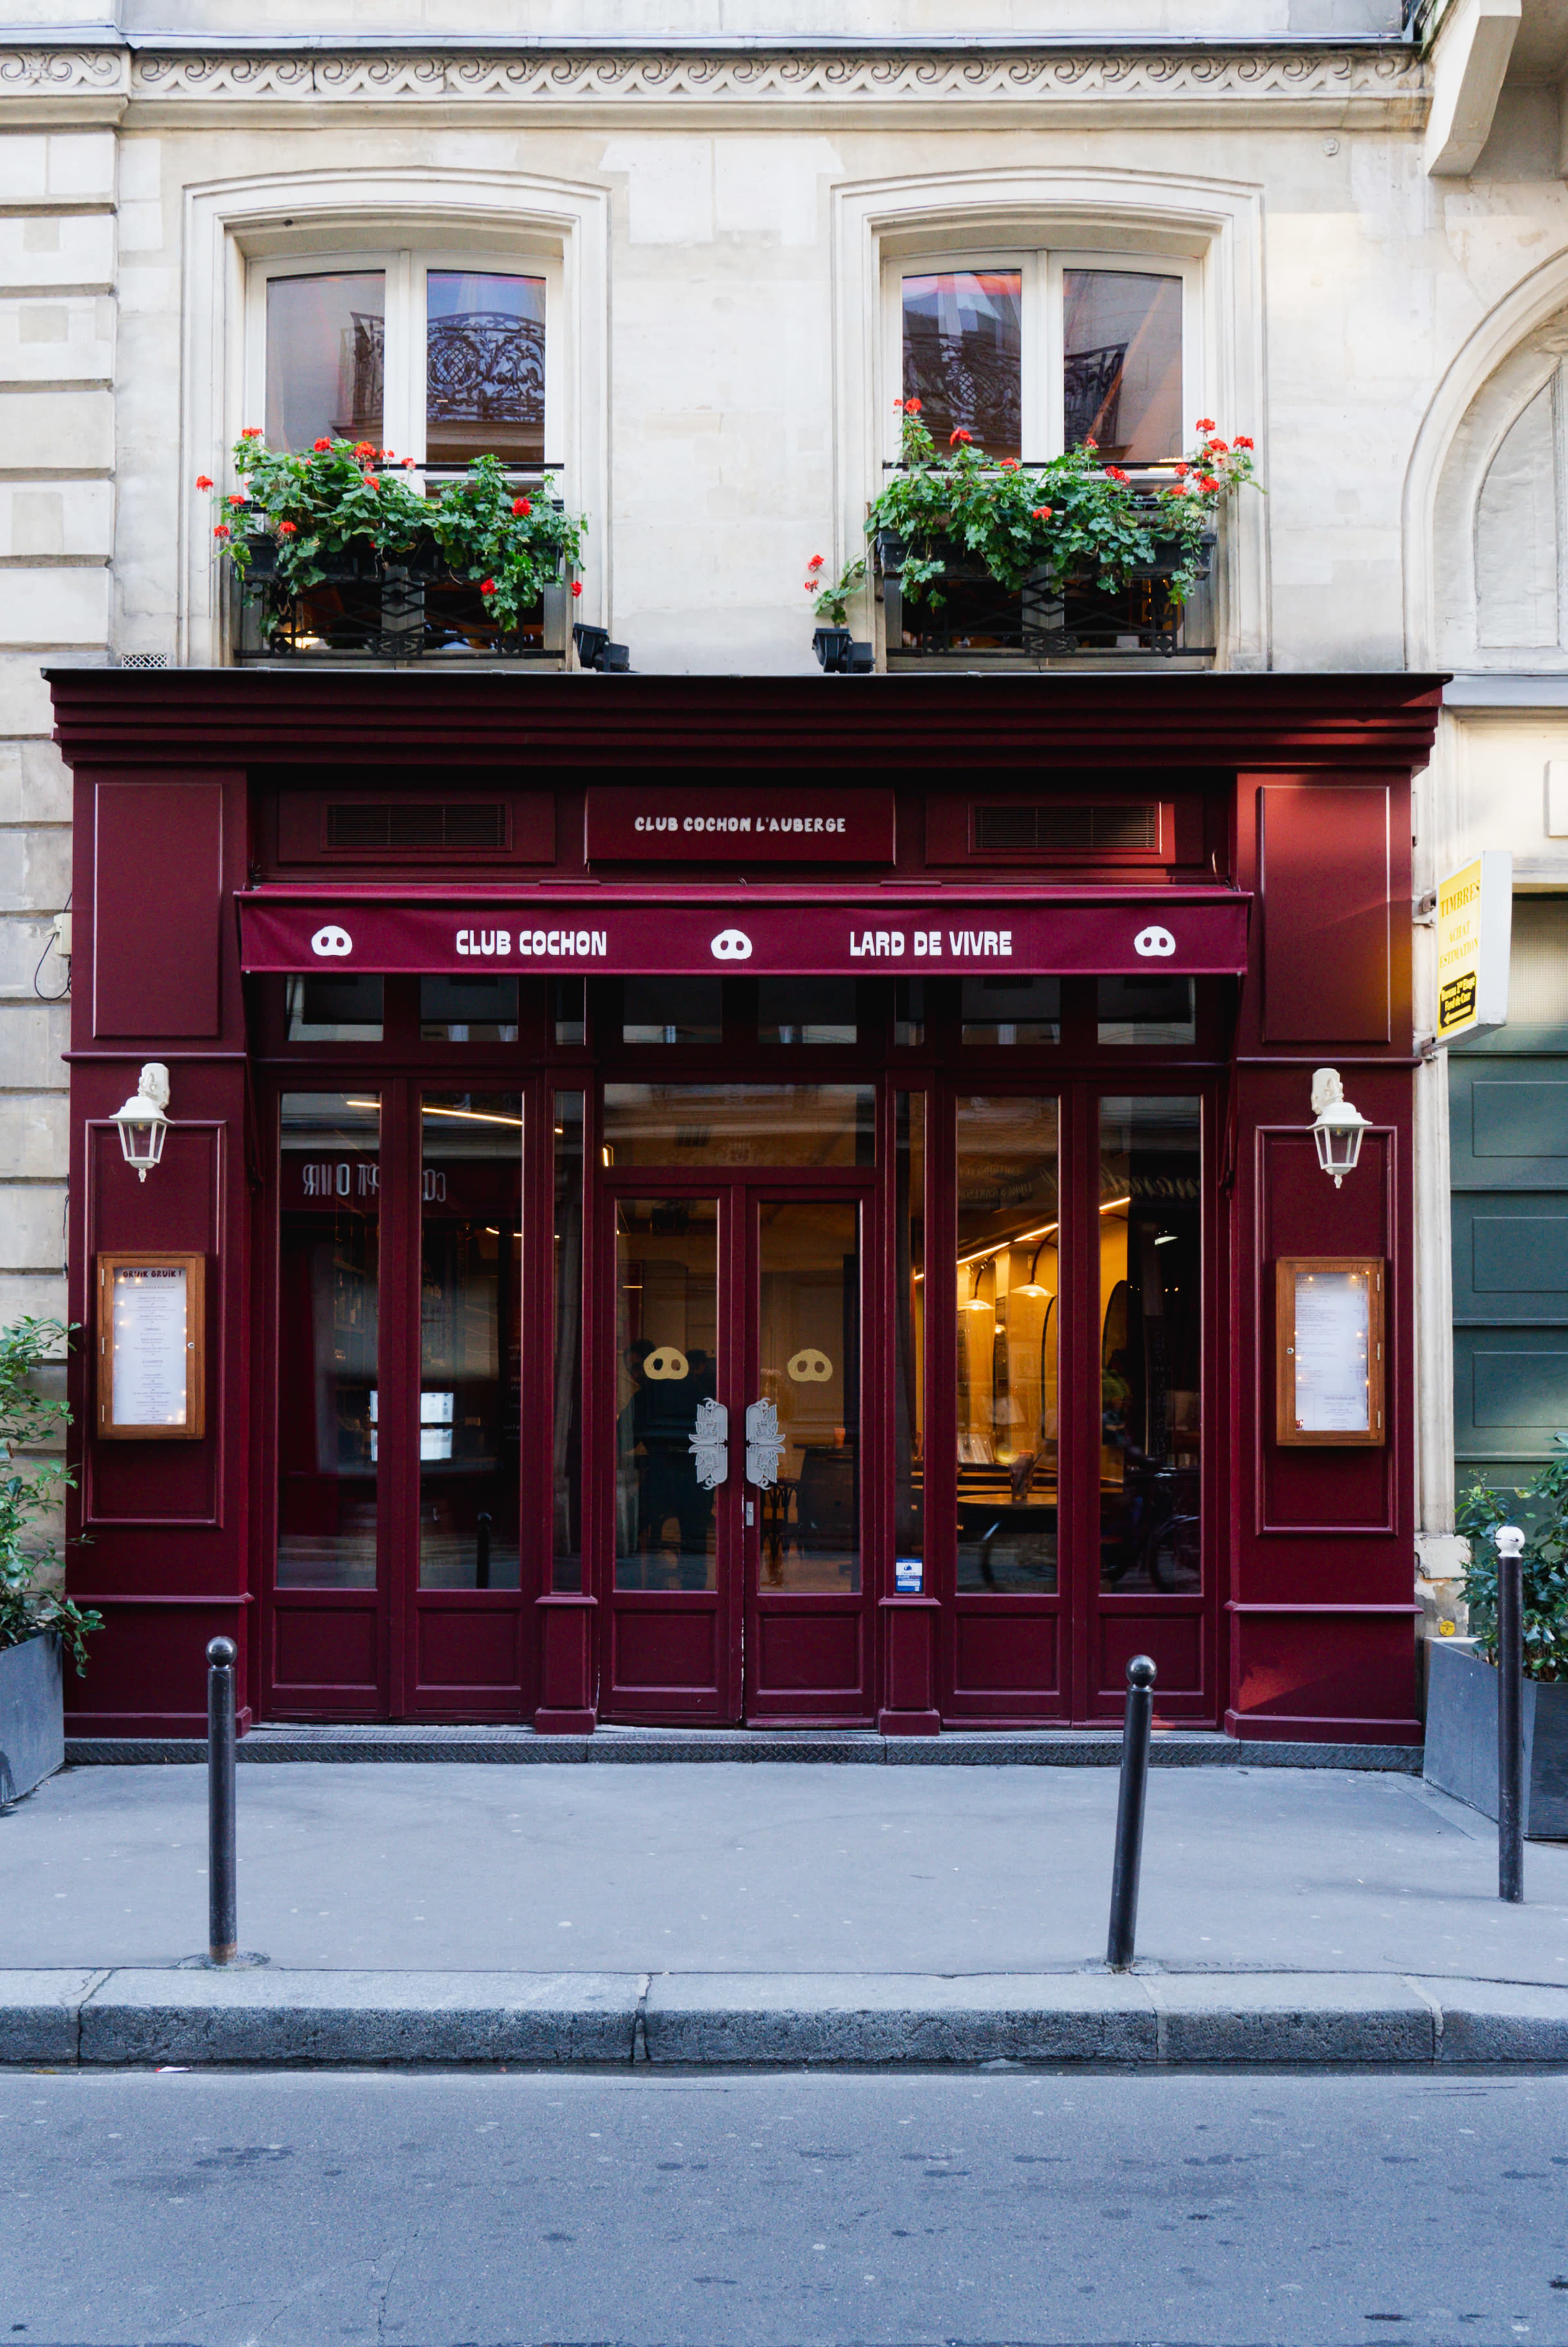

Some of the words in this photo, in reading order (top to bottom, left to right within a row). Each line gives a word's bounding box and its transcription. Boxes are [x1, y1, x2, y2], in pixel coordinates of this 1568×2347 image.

[635, 817, 678, 831] CLUB
[683, 817, 751, 832] COCHON
[756, 817, 846, 832] L'AUBERGE
[1441, 879, 1480, 918] TIMBRES
[456, 929, 511, 955] CLUB
[519, 930, 607, 956] COCHON
[850, 931, 905, 957] LARD
[913, 931, 942, 956] DE
[949, 931, 1013, 956] VIVRE
[1450, 920, 1470, 943] ACHAT
[1439, 937, 1478, 969] ESTIMATION
